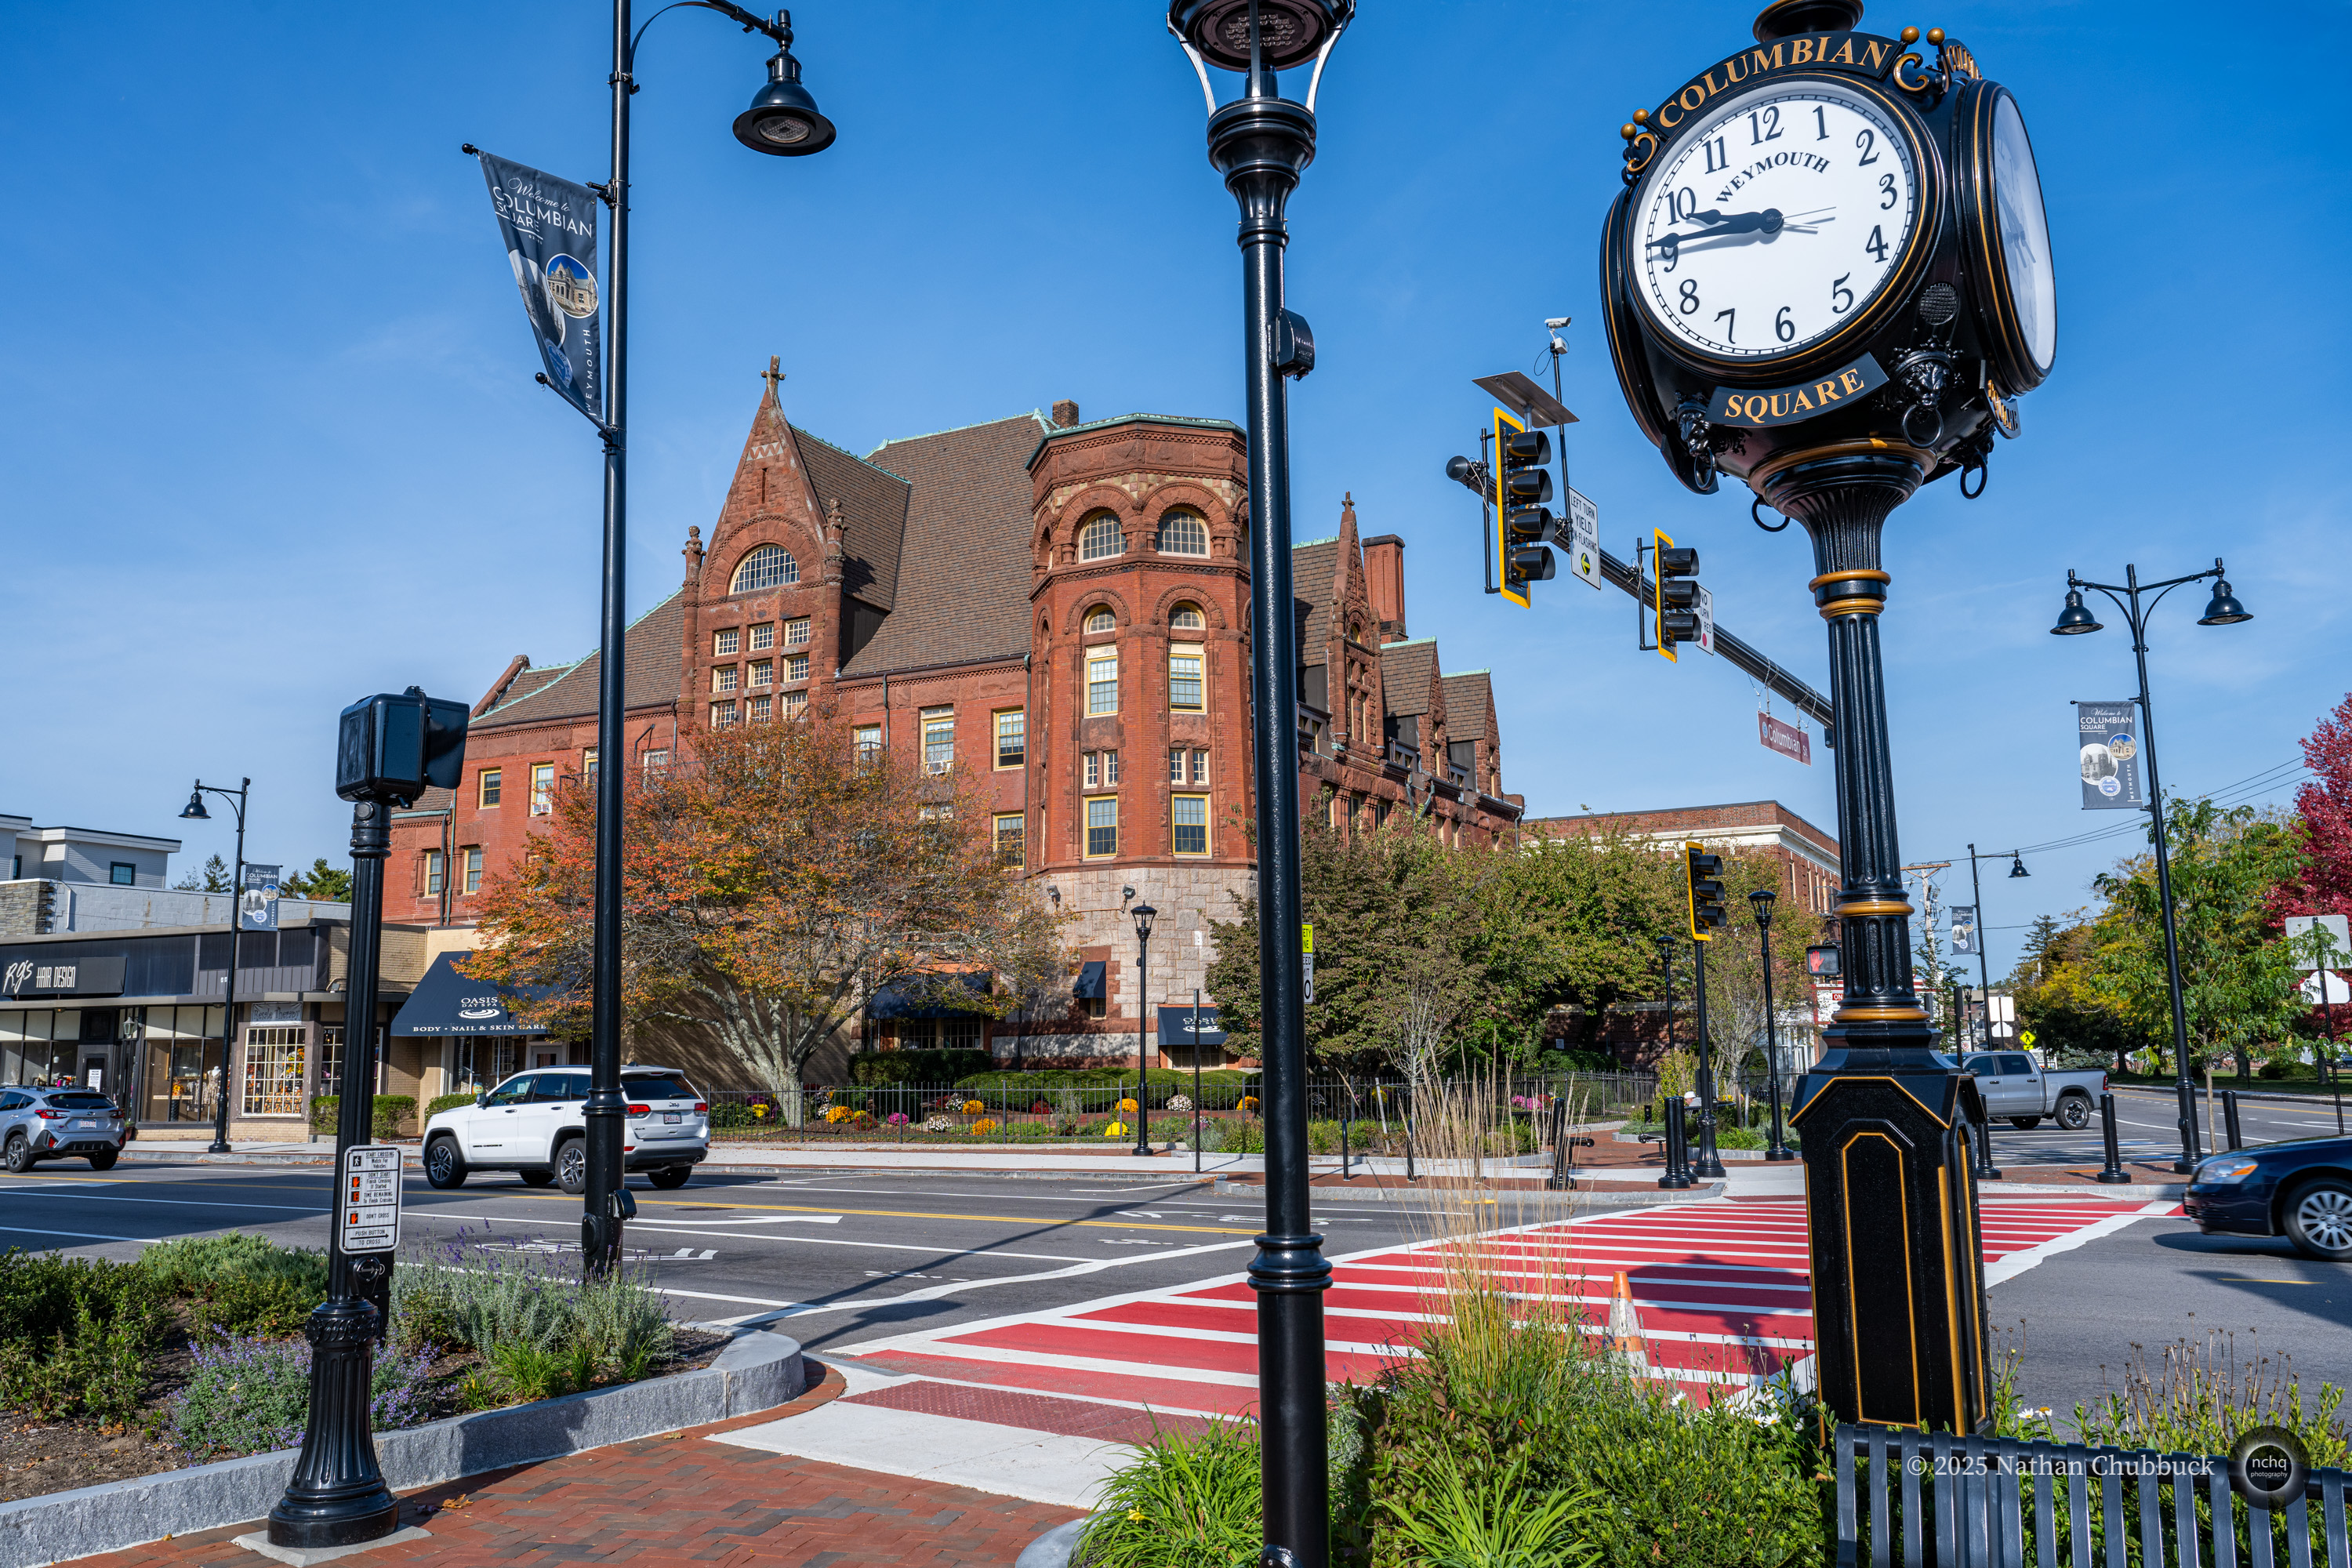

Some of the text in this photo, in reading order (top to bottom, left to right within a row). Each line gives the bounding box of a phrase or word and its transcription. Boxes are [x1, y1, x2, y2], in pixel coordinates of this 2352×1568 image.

[1659, 36, 1893, 129] COLUMBIAN
[1748, 106, 1784, 146] 12
[1813, 105, 1830, 141] 1
[1702, 136, 1730, 175] 11
[1857, 129, 1880, 166] 2
[508, 177, 571, 212] Welcome to
[1715, 151, 1831, 202] WEYMOUTH
[1878, 173, 1897, 210] 3
[492, 186, 592, 239] COLUMBIAN
[1664, 187, 1697, 226] 10
[1661, 241, 1679, 273] 9
[1865, 224, 1889, 263] 4
[1679, 279, 1700, 315] 8
[1831, 272, 1854, 314] 5
[1714, 308, 1737, 344] 7
[1775, 306, 1795, 343] 6
[1724, 368, 1865, 423] SQUARE
[1570, 494, 1595, 521] LEFT TURN
[1575, 512, 1592, 535] YIELD
[1768, 724, 1808, 757] Columbian St
[35, 966, 76, 988] HAIR DESIGN
[1304, 979, 1311, 1000] 0
[254, 1007, 300, 1020] Resale Therapy
